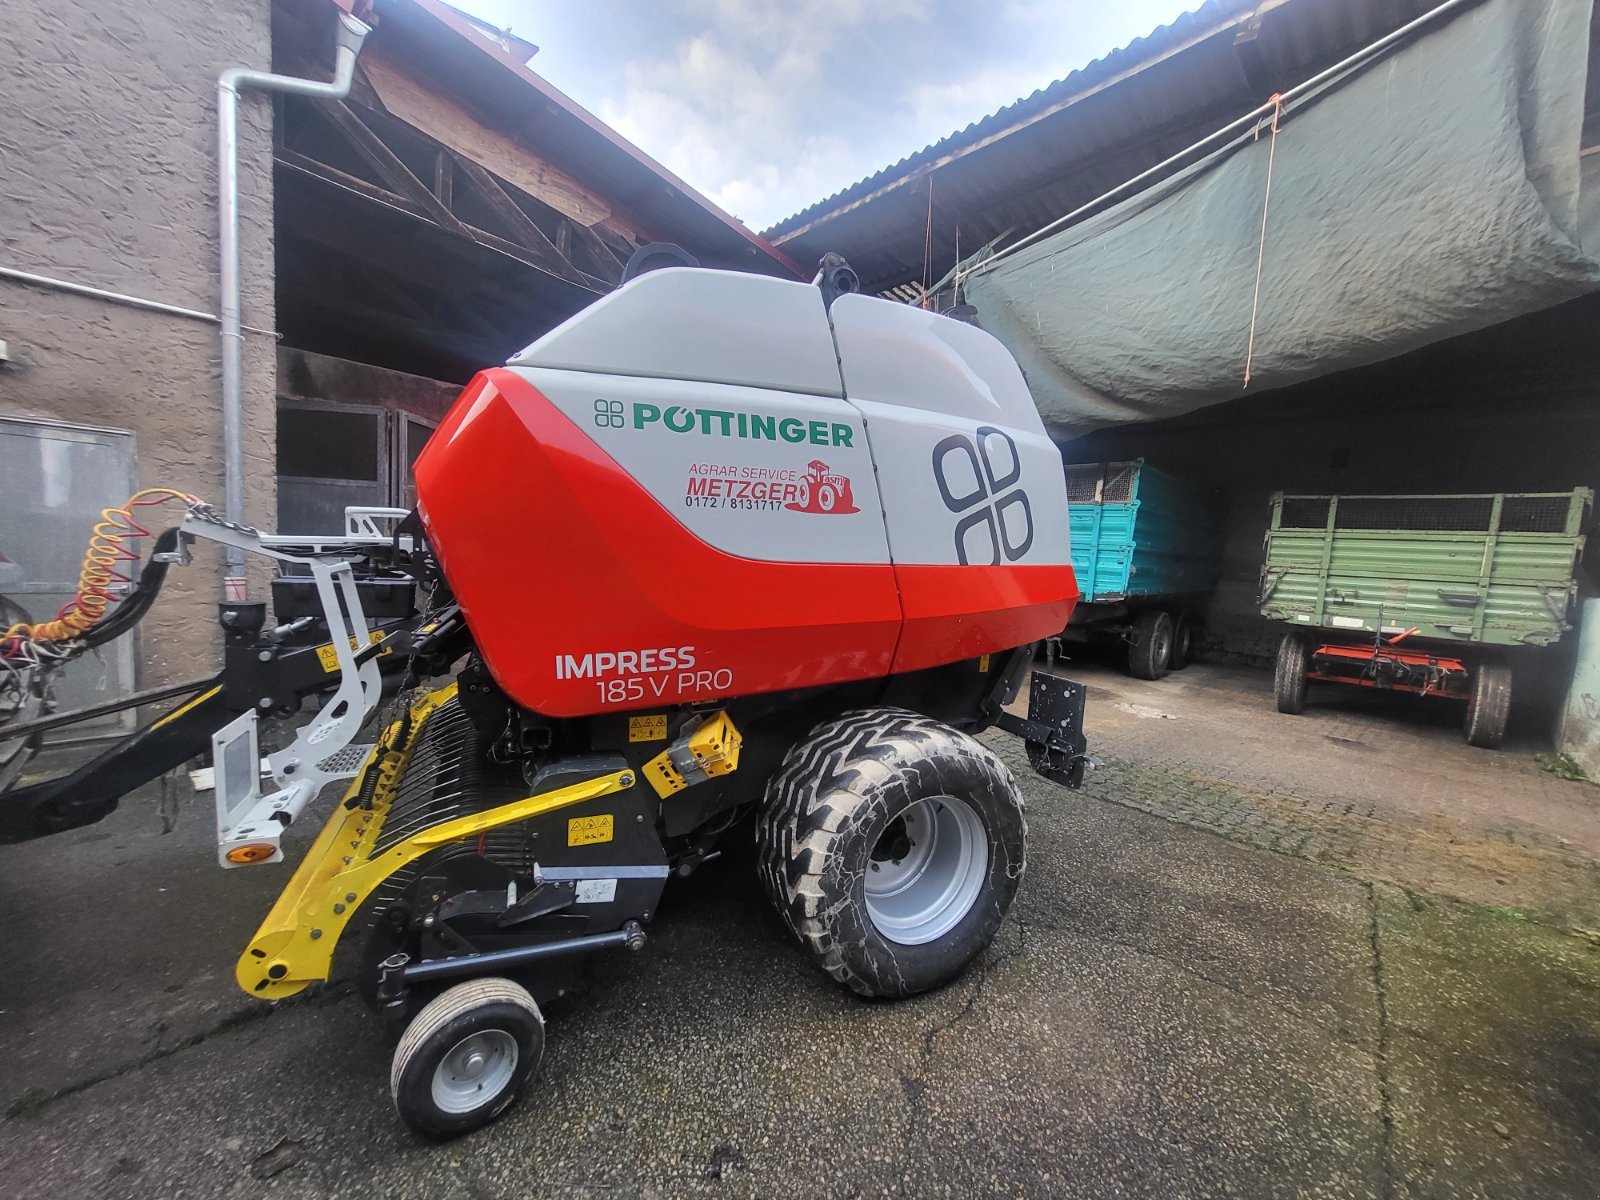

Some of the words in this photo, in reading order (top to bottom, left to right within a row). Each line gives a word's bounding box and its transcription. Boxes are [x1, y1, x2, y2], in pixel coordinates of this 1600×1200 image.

[633, 402, 854, 448] PÖTTINGER
[688, 463, 738, 478] AGRAR
[741, 467, 797, 482] SERVICE
[685, 496, 717, 508] 0172
[721, 498, 726, 509] /
[730, 498, 782, 511] 8131717
[686, 477, 798, 502] METZGER
[555, 646, 695, 680] IMPRESS
[596, 677, 644, 704] 185
[648, 674, 669, 697] V
[677, 668, 733, 694] PRO
